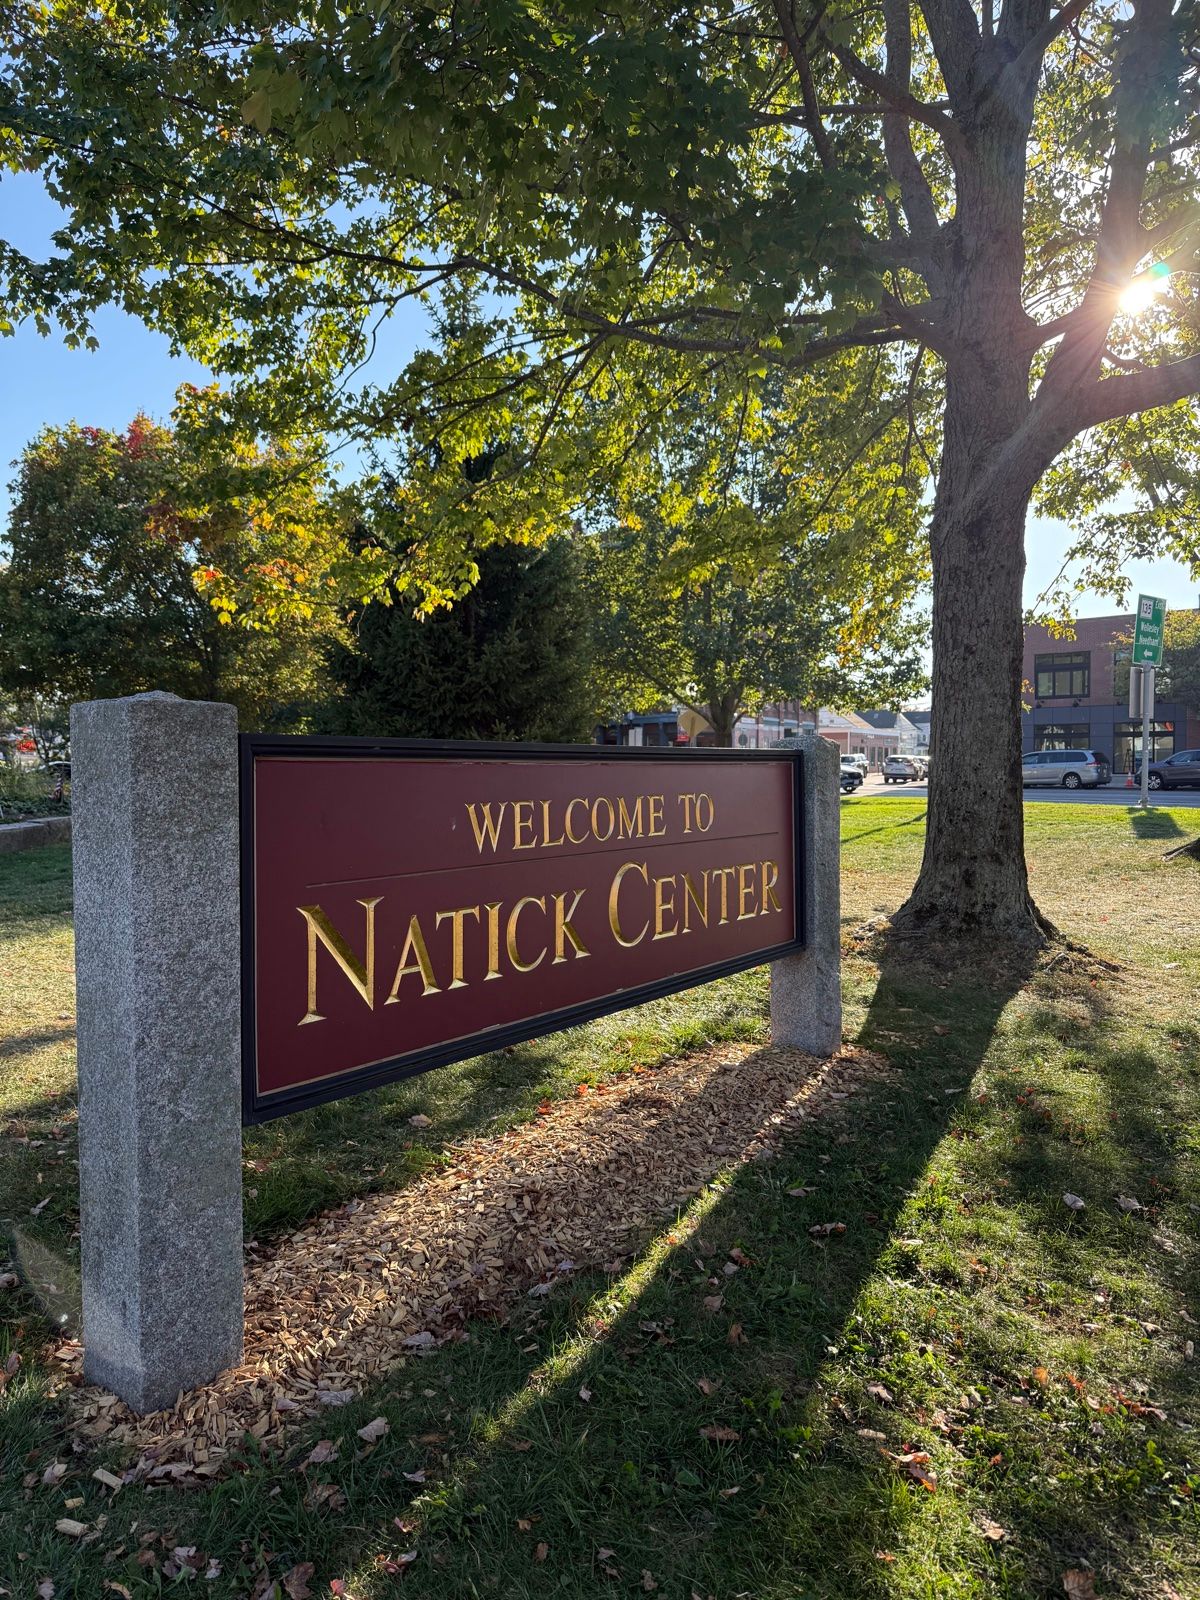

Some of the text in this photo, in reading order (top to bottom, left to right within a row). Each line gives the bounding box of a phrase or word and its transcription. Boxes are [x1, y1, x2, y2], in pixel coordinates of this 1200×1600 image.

[1142, 602, 1152, 615] 135
[465, 792, 715, 854] WELCOME TO
[295, 860, 783, 1027] NATICK CENTER
